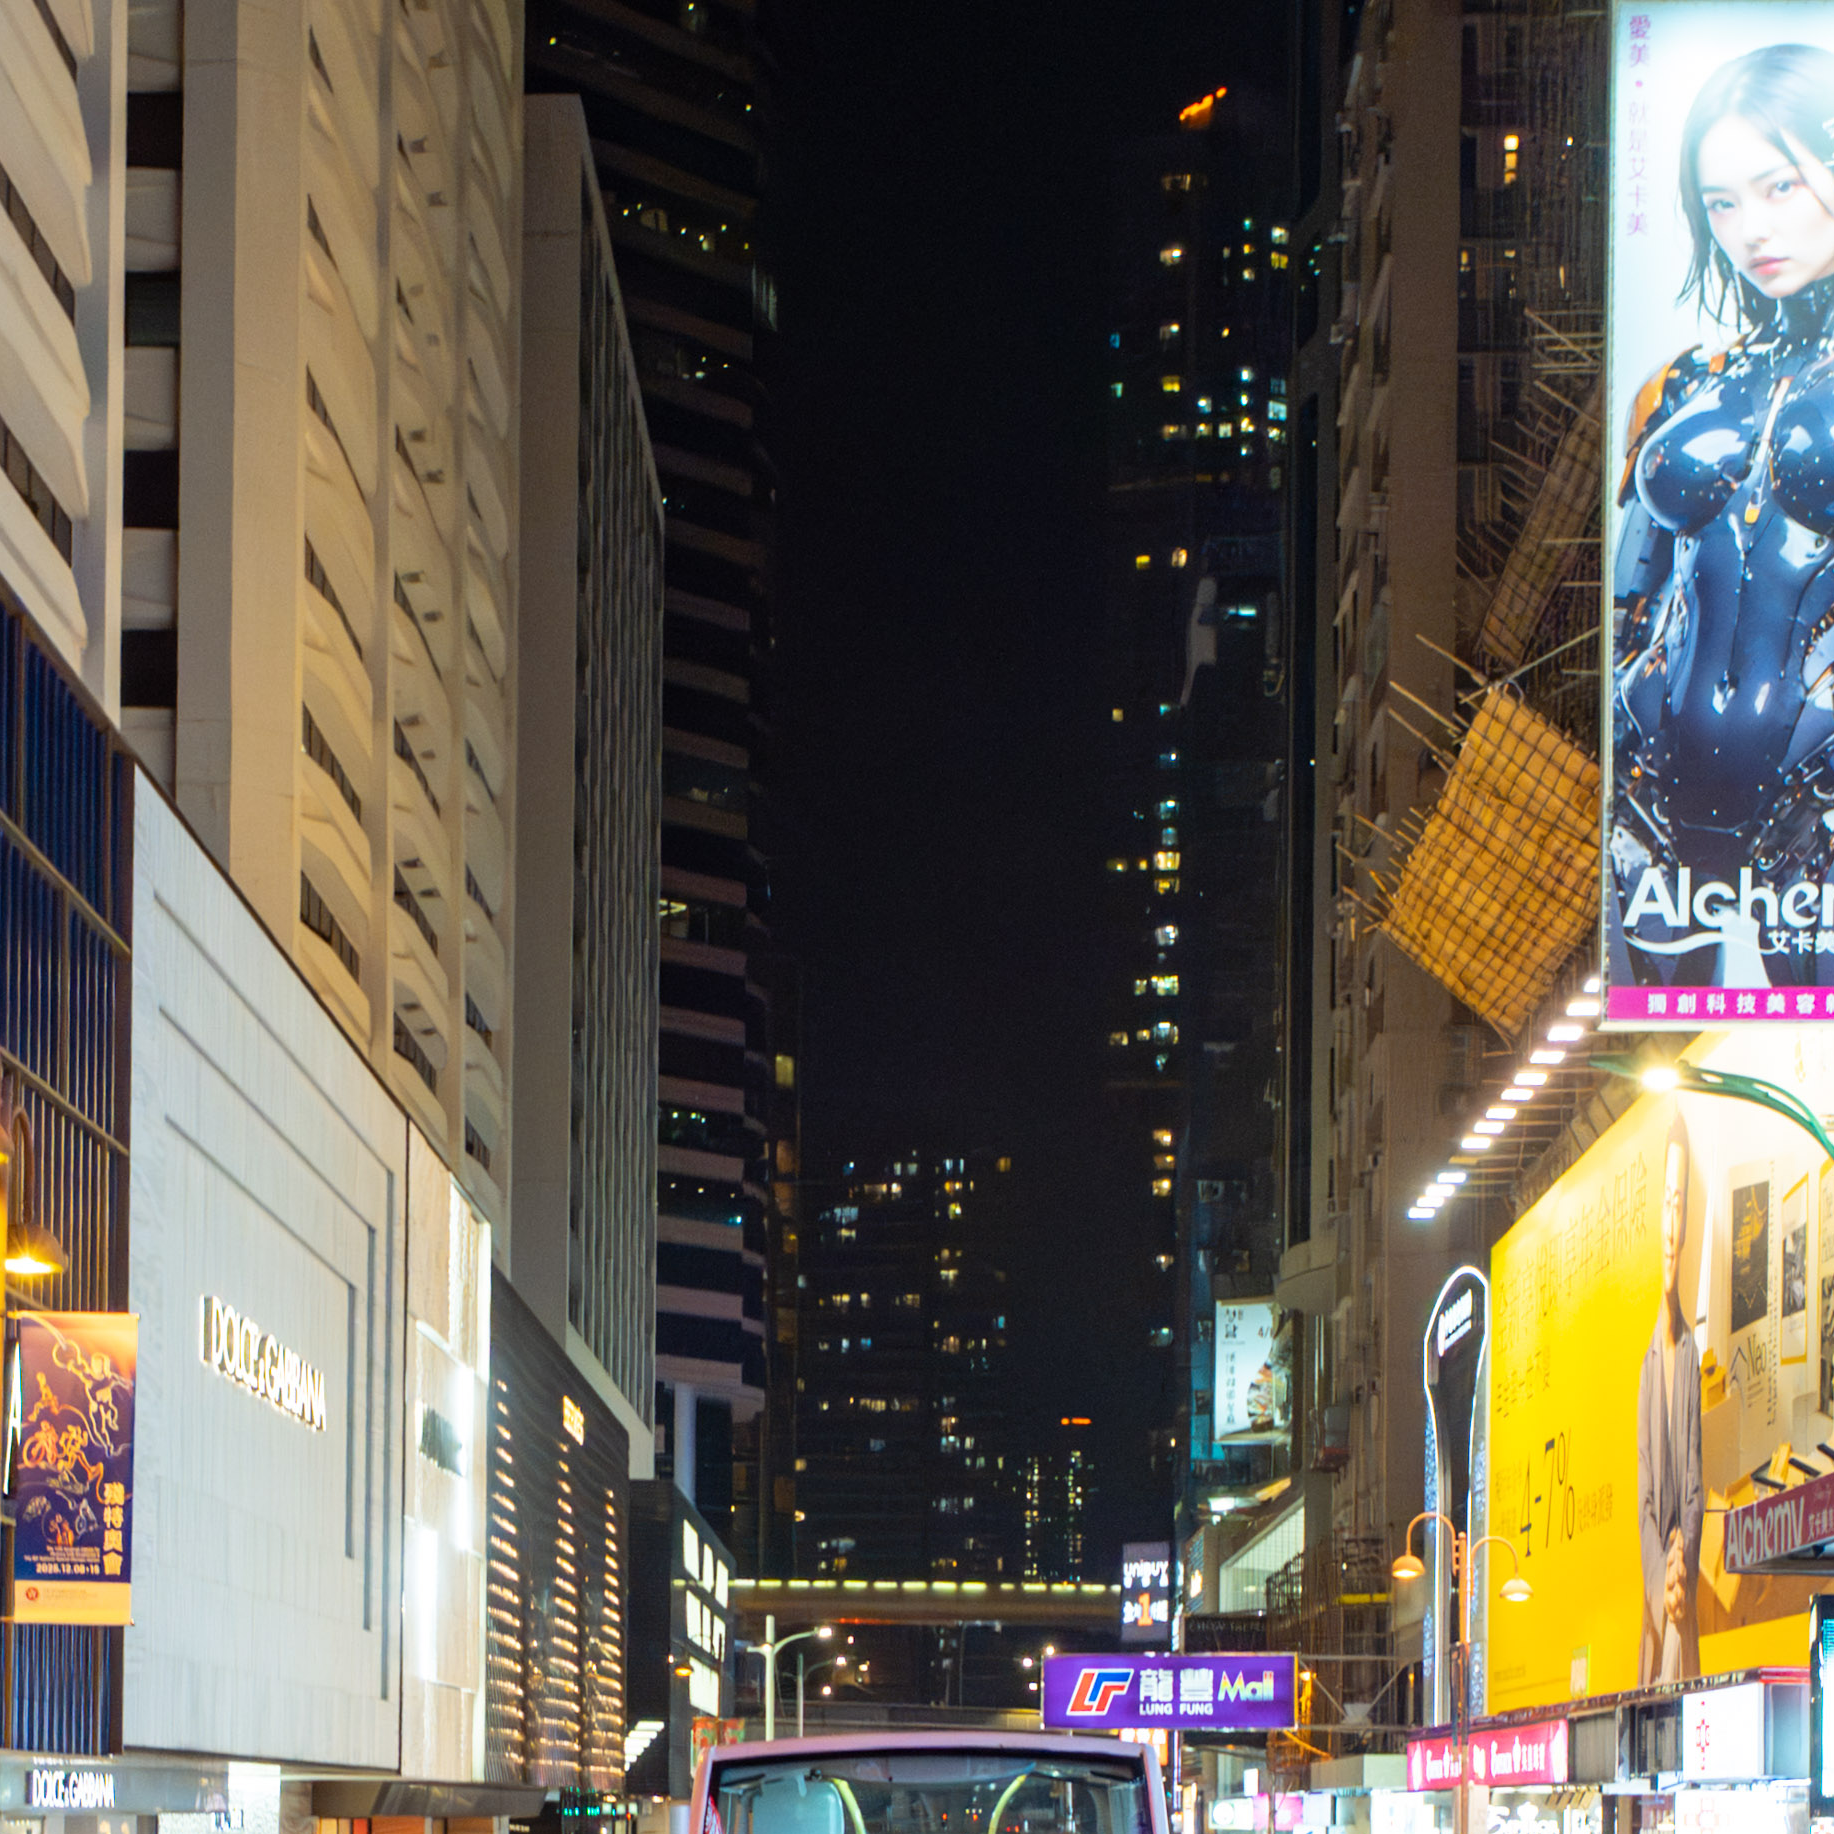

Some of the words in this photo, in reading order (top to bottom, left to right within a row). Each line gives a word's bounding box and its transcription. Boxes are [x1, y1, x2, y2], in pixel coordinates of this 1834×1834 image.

[1725, 1497, 1805, 1571] Alchemy
[1139, 1667, 1215, 1702] 龍豐
[1217, 1669, 1275, 1703] Mall
[1139, 1703, 1174, 1716] LUNG
[1179, 1703, 1215, 1716] FUNG
